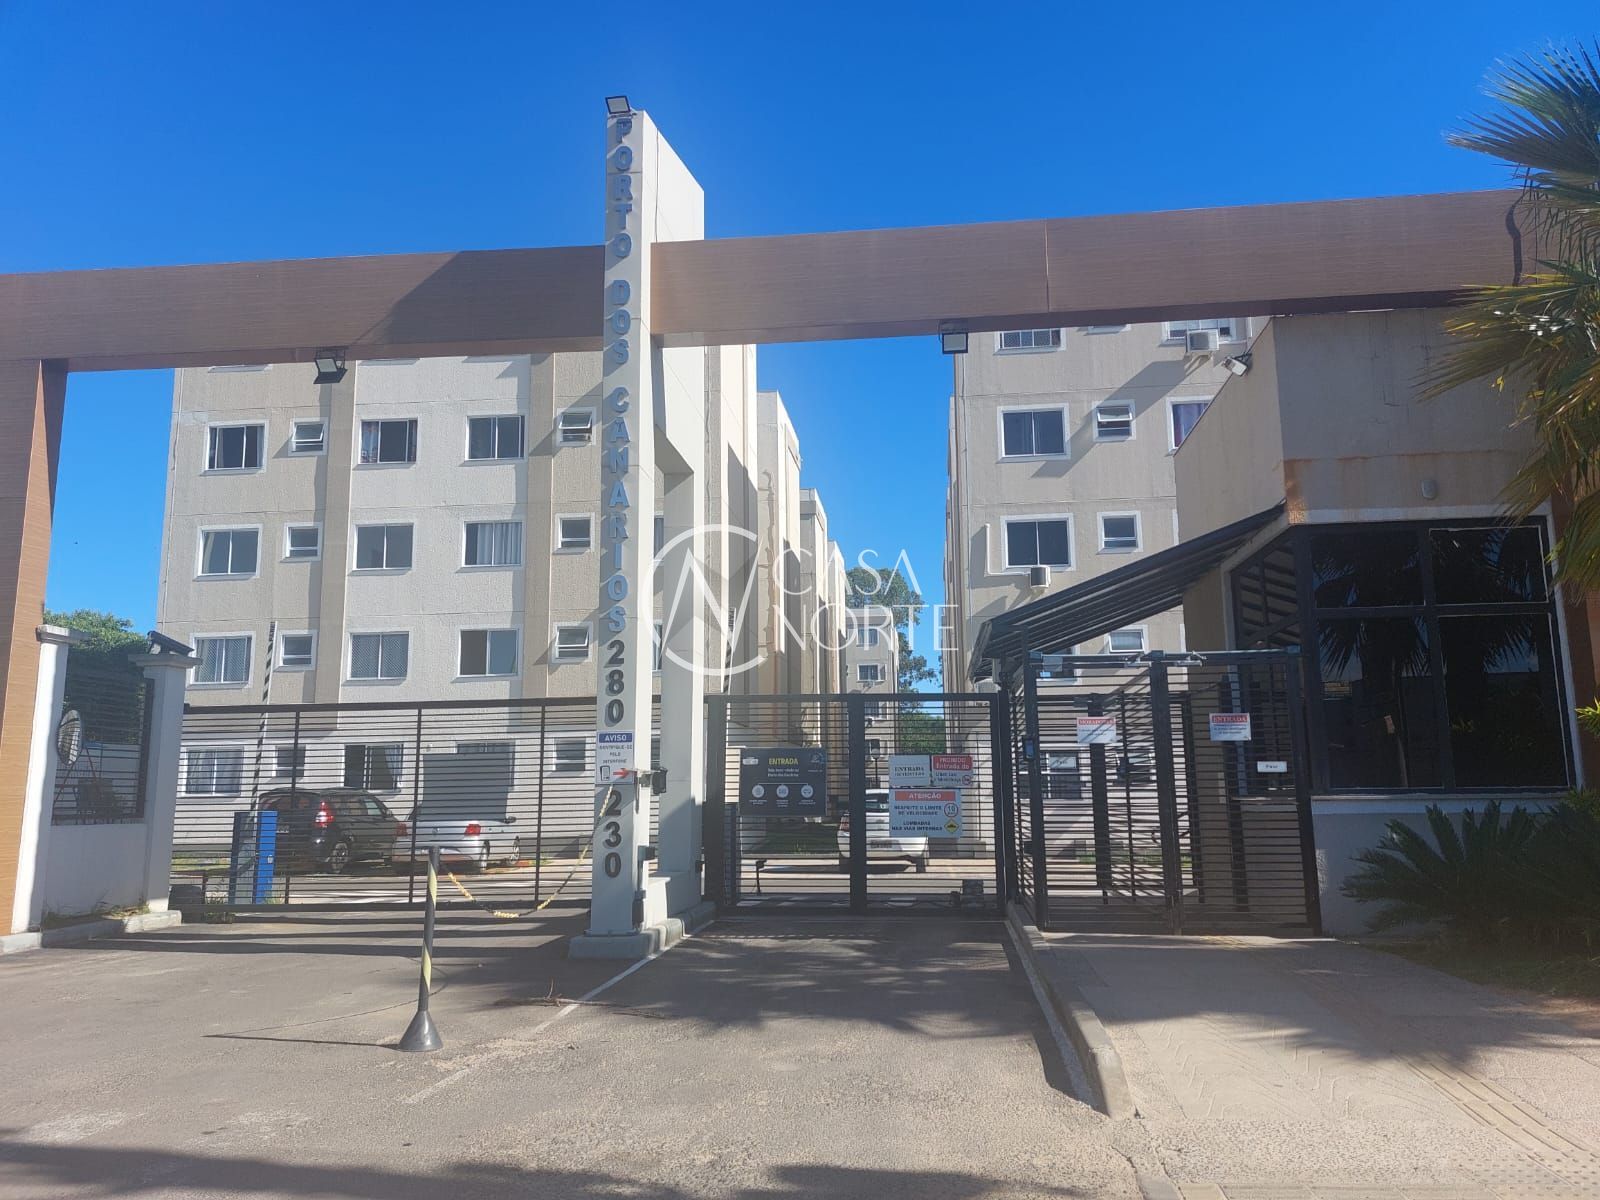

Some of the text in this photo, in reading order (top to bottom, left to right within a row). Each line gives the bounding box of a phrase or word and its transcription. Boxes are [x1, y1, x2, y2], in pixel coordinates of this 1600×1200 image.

[614, 118, 633, 258] PORTO
[611, 279, 631, 364] DOS
[607, 639, 625, 725] 280
[604, 734, 627, 742] AVISO
[768, 757, 799, 765] ENTRADA
[908, 791, 942, 799] ATENÇÃO
